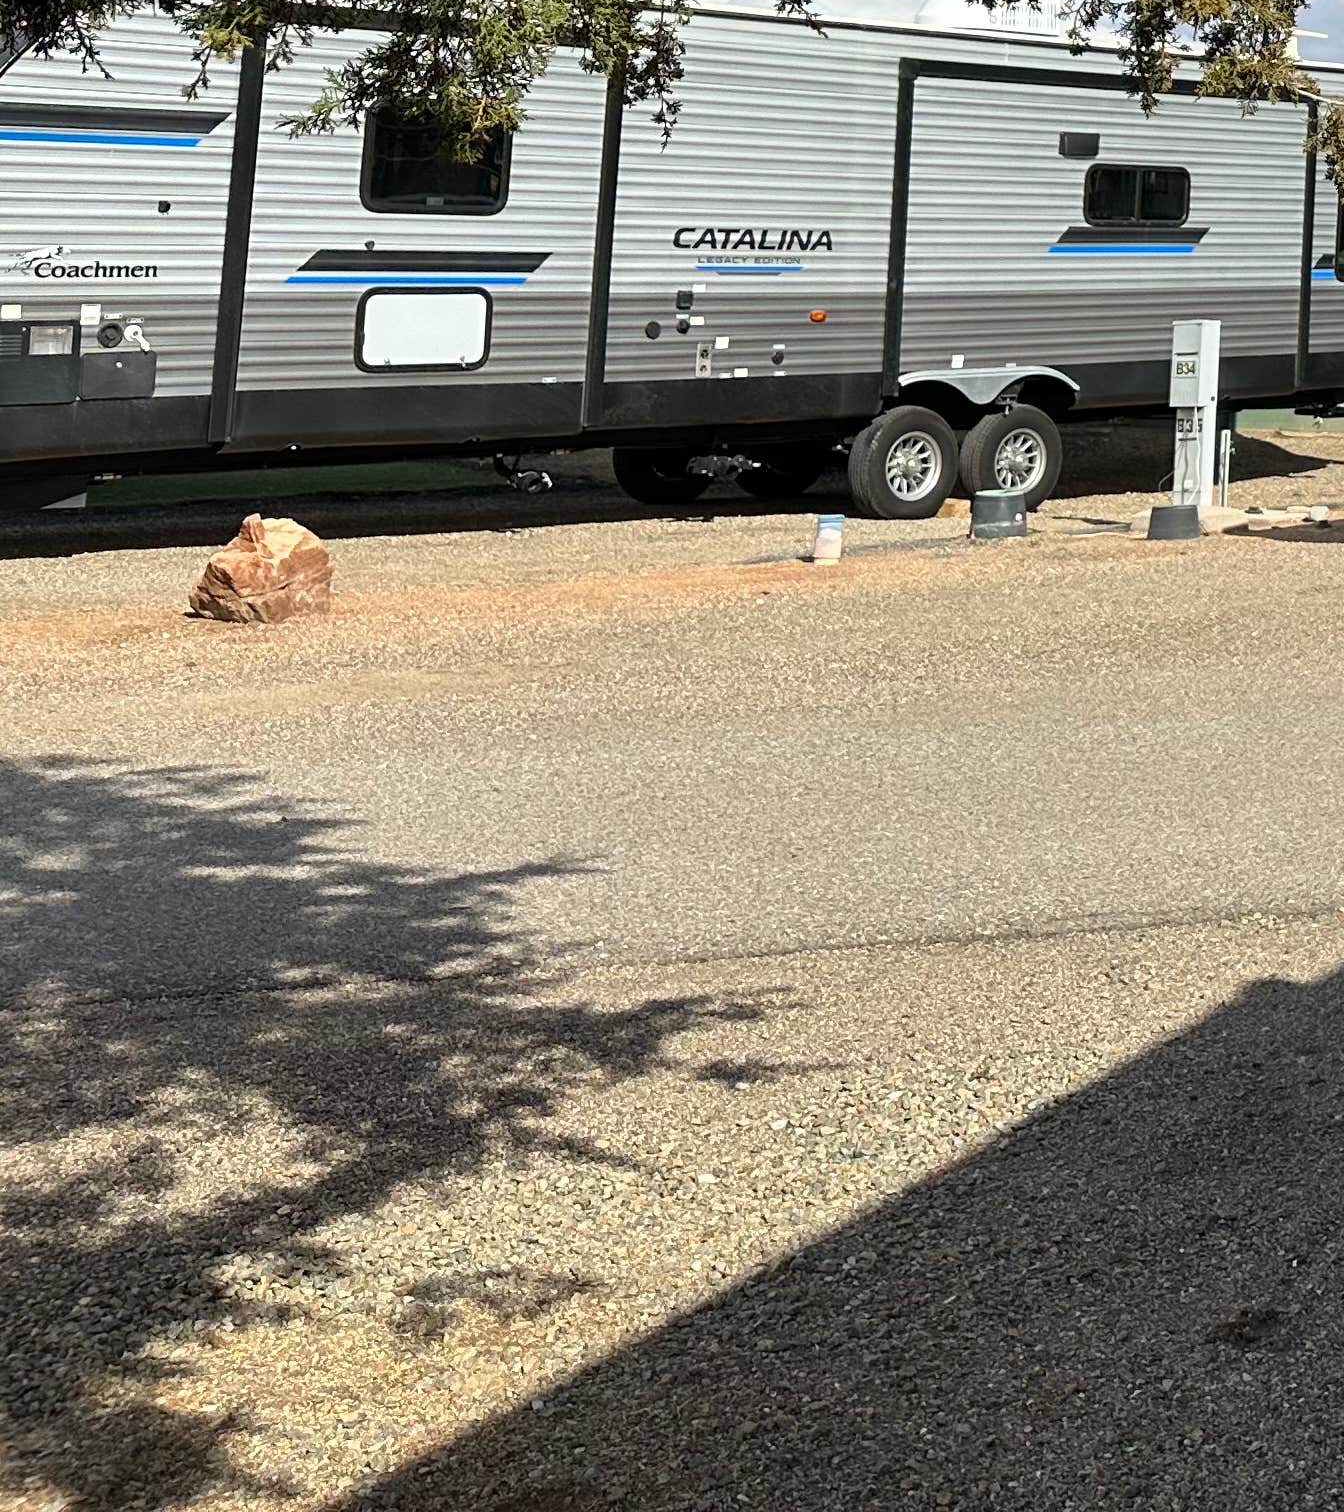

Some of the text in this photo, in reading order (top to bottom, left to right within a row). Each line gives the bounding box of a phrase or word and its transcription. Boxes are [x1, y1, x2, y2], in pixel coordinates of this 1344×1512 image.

[673, 227, 833, 251] CATALINA
[698, 256, 801, 265] LEGACY EDITION
[34, 261, 158, 279] Coachmen
[1176, 362, 1195, 375] B34
